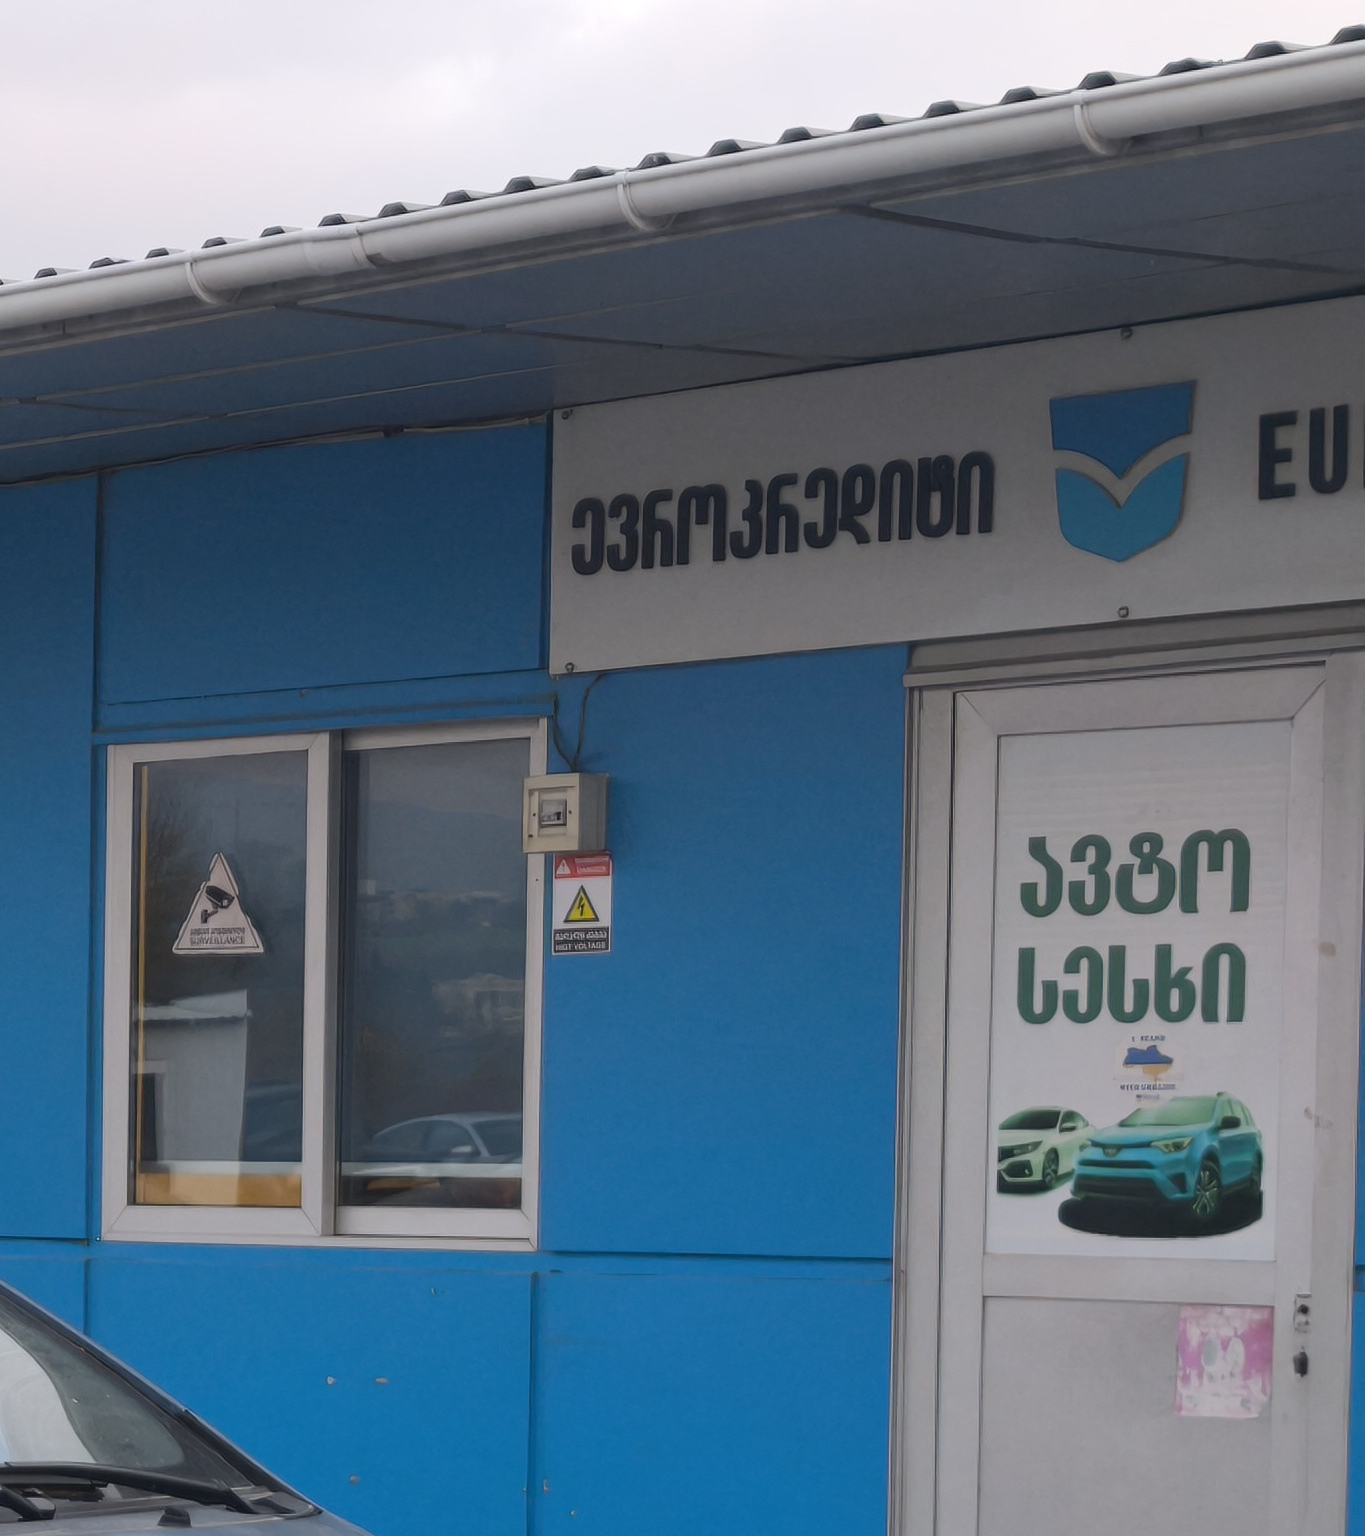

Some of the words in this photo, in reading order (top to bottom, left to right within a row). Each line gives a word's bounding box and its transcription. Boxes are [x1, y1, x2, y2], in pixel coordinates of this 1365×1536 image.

[1258, 403, 1365, 500] EU
[571, 451, 996, 576] ევროკრედიტი
[1019, 828, 1252, 918] ავტო
[1016, 942, 1248, 1025] სესხი
